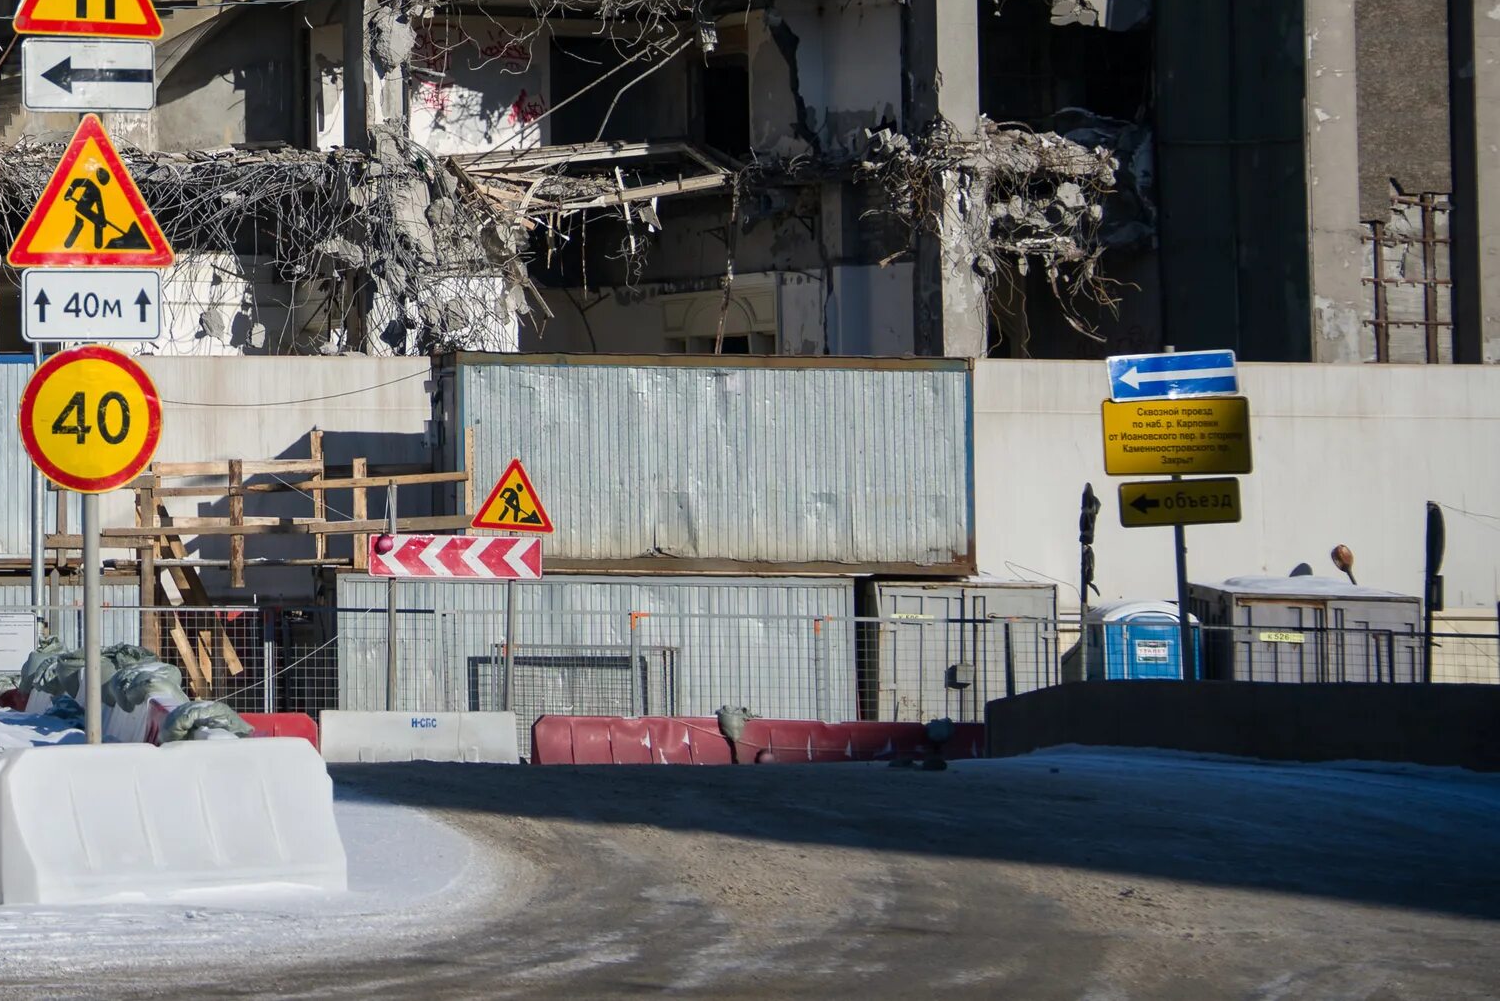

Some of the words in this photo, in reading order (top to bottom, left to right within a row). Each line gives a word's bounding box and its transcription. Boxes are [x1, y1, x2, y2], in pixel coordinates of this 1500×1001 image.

[1136, 407, 1179, 416] Сквозной
[1181, 408, 1213, 417] проезд
[51, 391, 131, 445] 40
[1146, 420, 1163, 428] наб.
[1166, 421, 1173, 430] р.
[1176, 419, 1219, 429] Карповки
[1121, 432, 1177, 441] Иоановского
[1180, 432, 1197, 441] пер.
[1123, 444, 1216, 454] Каменноостровского
[1161, 455, 1194, 466] Закрыт
[1163, 491, 1233, 510] объезд
